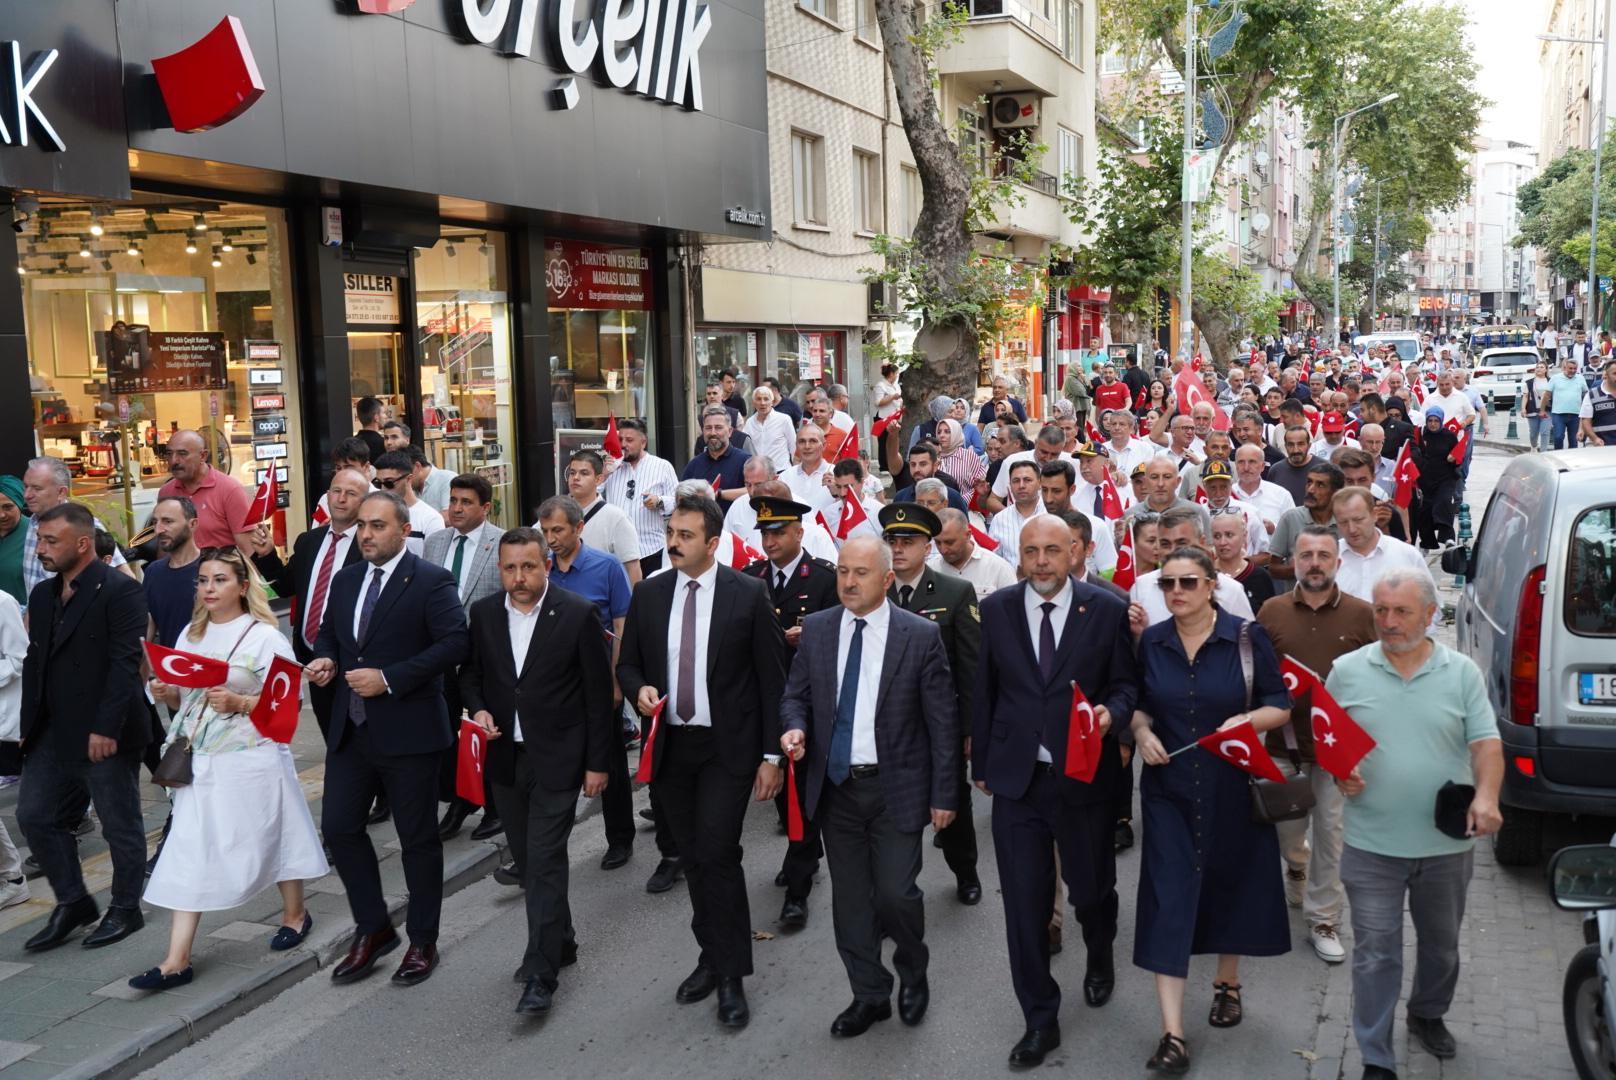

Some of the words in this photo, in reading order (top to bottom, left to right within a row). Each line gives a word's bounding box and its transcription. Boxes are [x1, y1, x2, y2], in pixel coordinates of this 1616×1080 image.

[0, 40, 66, 152] K
[344, 274, 393, 292] SILLER
[592, 270, 618, 284] MARKASI
[259, 422, 279, 431] oppo
